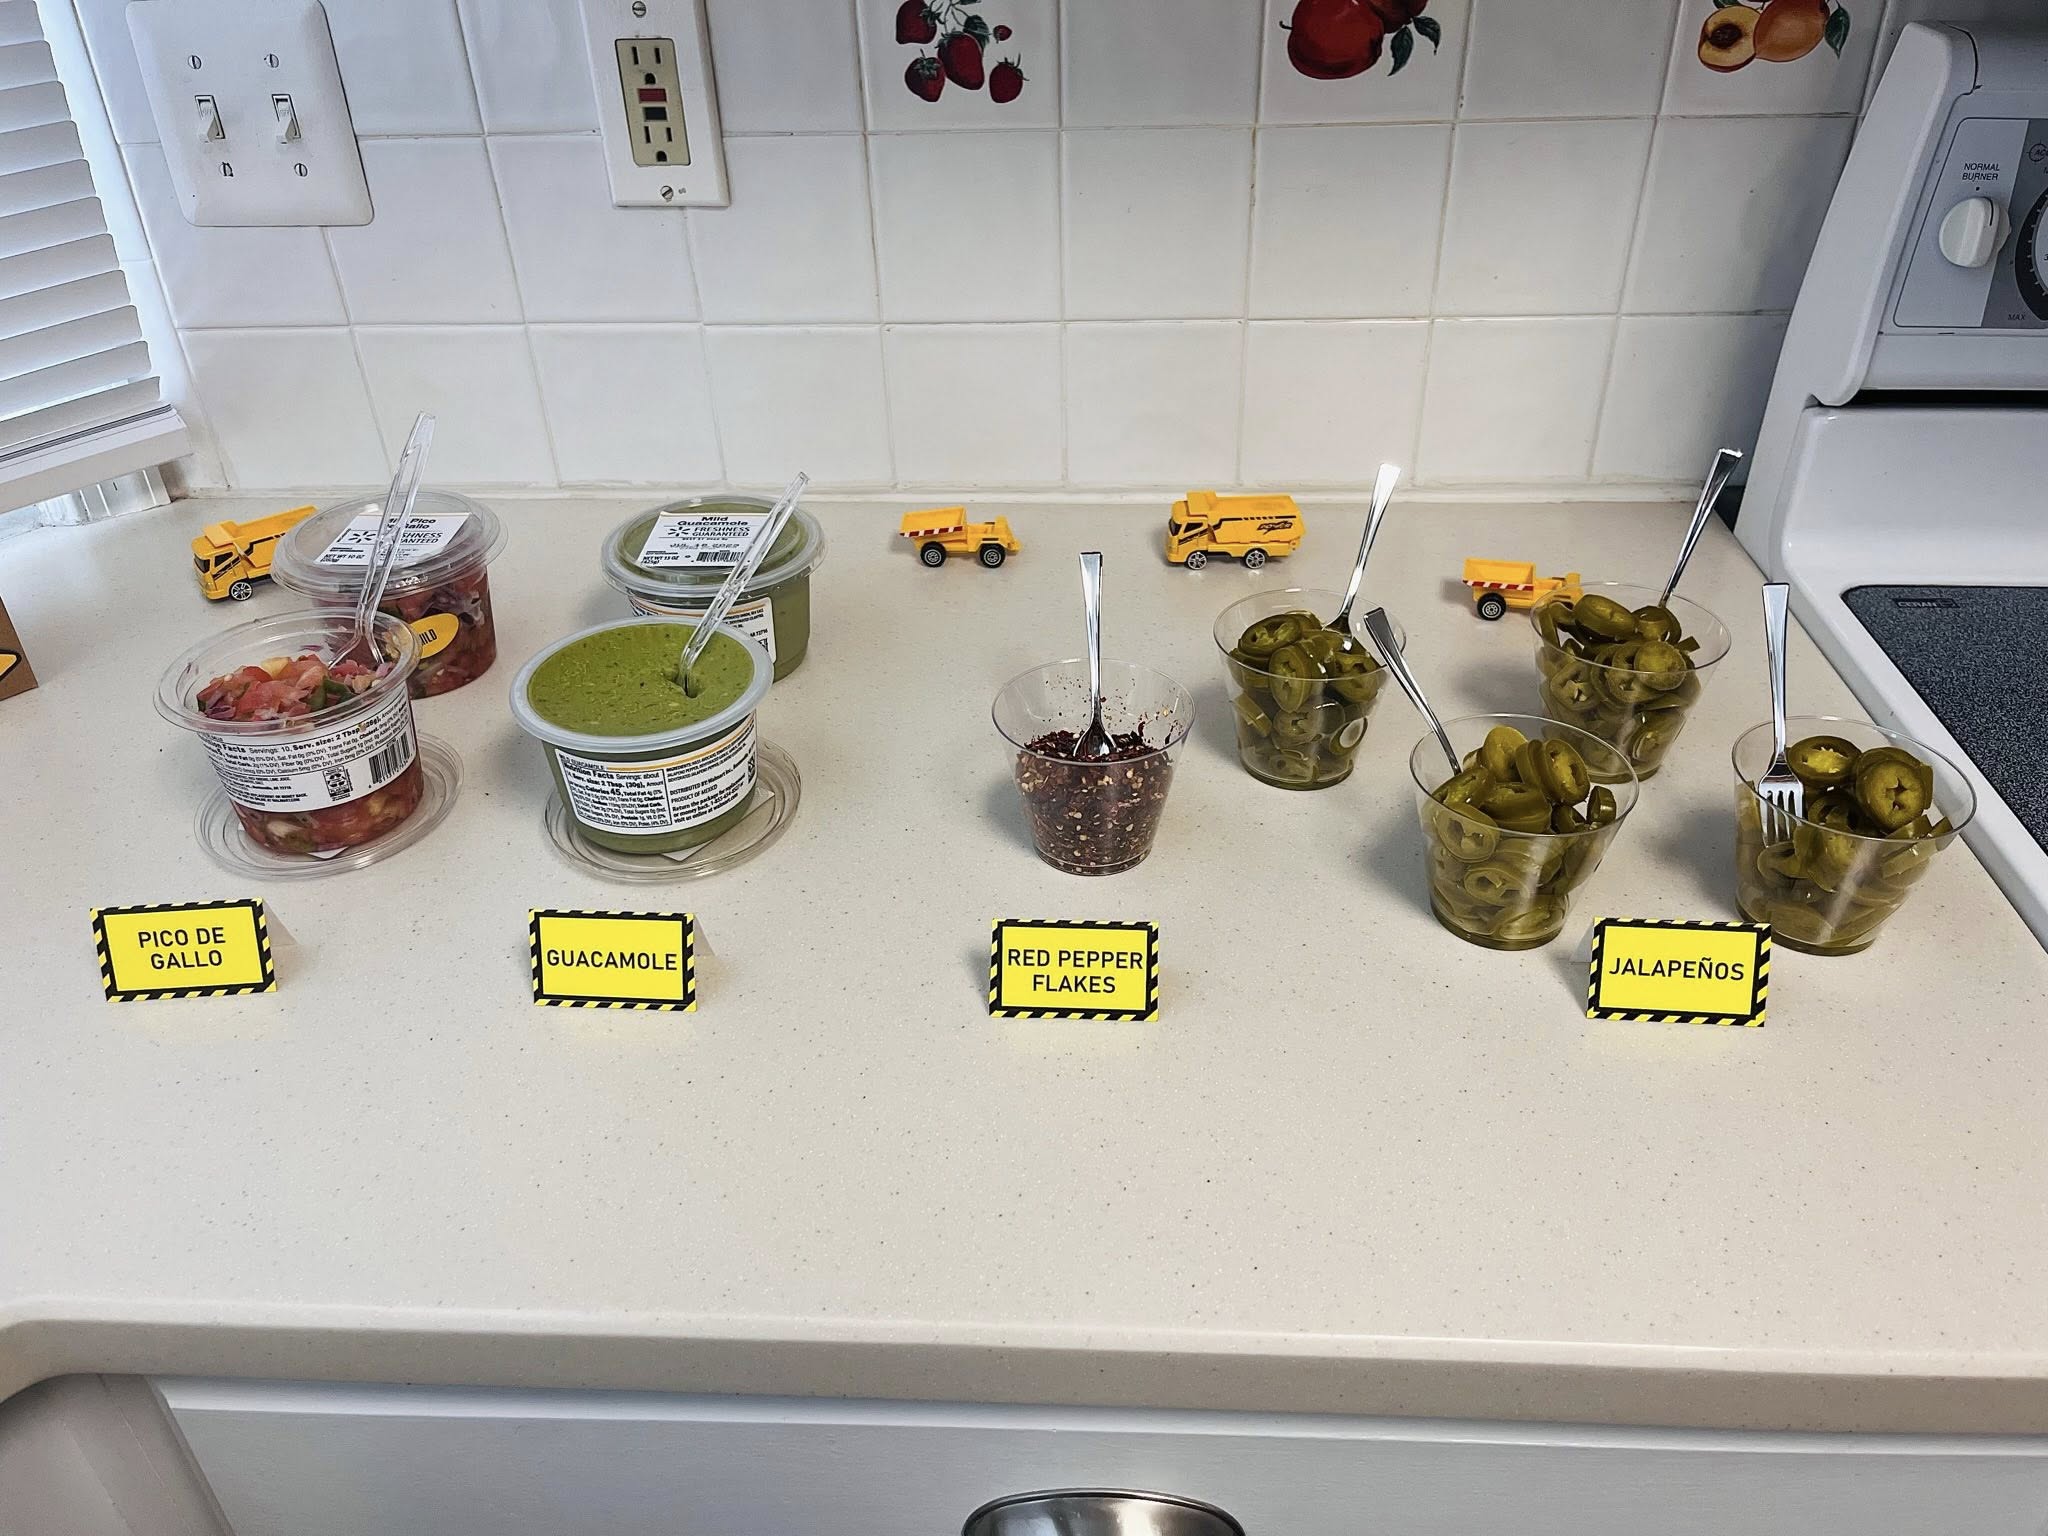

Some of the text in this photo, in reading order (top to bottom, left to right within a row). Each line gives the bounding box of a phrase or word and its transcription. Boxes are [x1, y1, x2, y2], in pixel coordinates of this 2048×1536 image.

[1963, 163, 2000, 172] NORMAL
[1961, 172, 1999, 182] BURNER
[2007, 313, 2026, 321] MAX
[223, 743, 247, 753] Facts
[293, 742, 315, 751] Serv.
[316, 738, 335, 746] size:
[593, 772, 614, 780] Facts
[670, 782, 701, 795] DISTRIBUTED
[671, 793, 694, 804] PRODUCT
[701, 783, 718, 794] MEXICO
[672, 803, 691, 812] Return
[700, 792, 718, 805] package
[674, 815, 685, 823] visit
[692, 810, 708, 819] online
[679, 807, 697, 816] money
[137, 926, 226, 949] PICO DE
[150, 949, 223, 970] GALLO
[546, 949, 678, 971] GUACAMOLE
[1008, 948, 1143, 970] RED PEPPER
[1609, 953, 1744, 981] JALAPEÑOS
[1033, 974, 1116, 994] FLAKES
